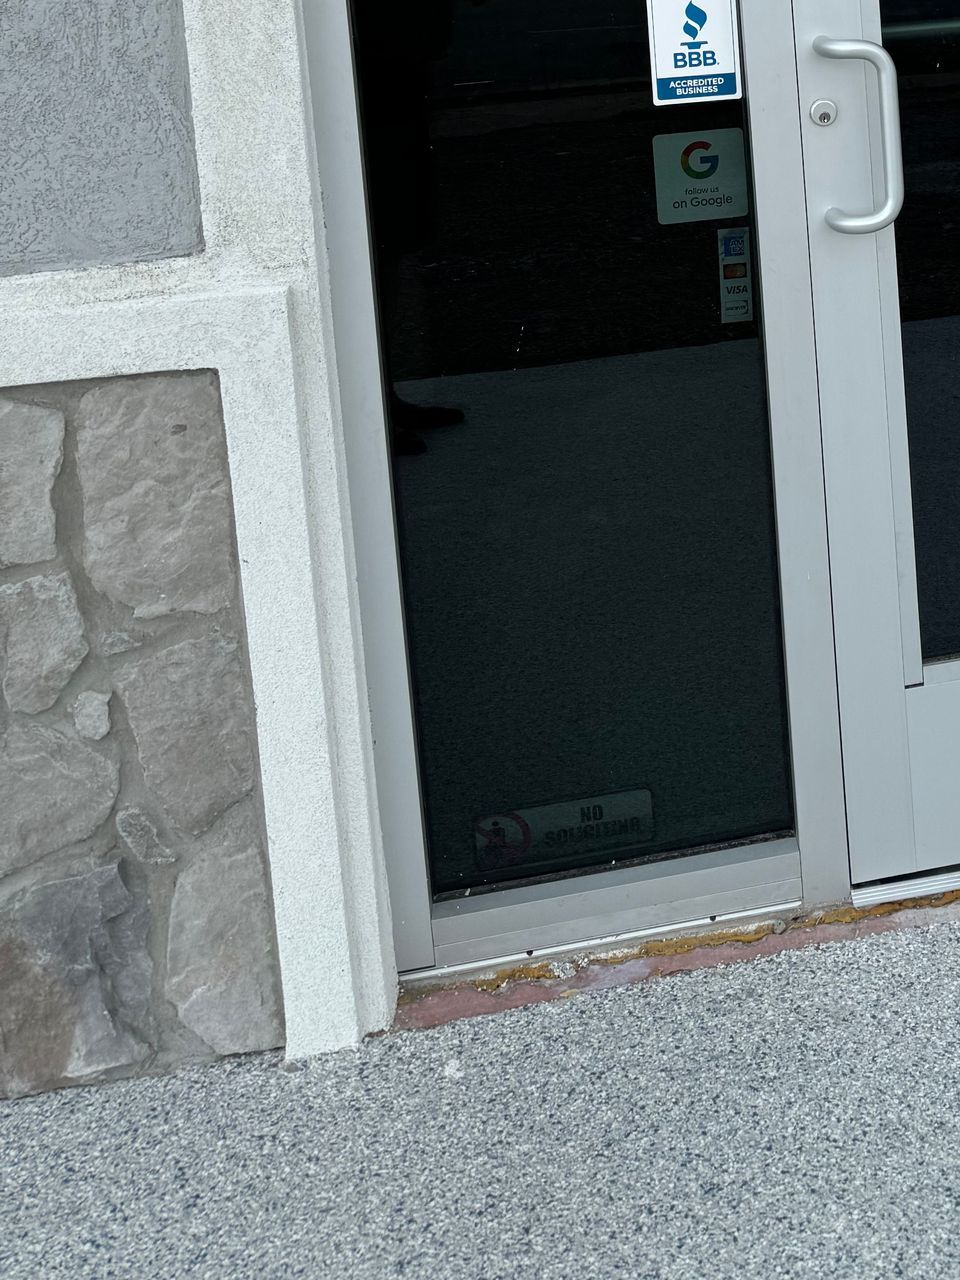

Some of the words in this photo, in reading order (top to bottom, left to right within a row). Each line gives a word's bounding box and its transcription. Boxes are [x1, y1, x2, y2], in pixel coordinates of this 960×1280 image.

[673, 50, 718, 69] BBB
[669, 77, 725, 88] ACCREDITED
[676, 86, 719, 96] BUSINESS
[680, 140, 719, 179] G
[685, 186, 709, 196] follow
[673, 198, 688, 209] on
[690, 194, 733, 209] Google
[726, 285, 748, 295] VISA
[580, 804, 604, 823] NO
